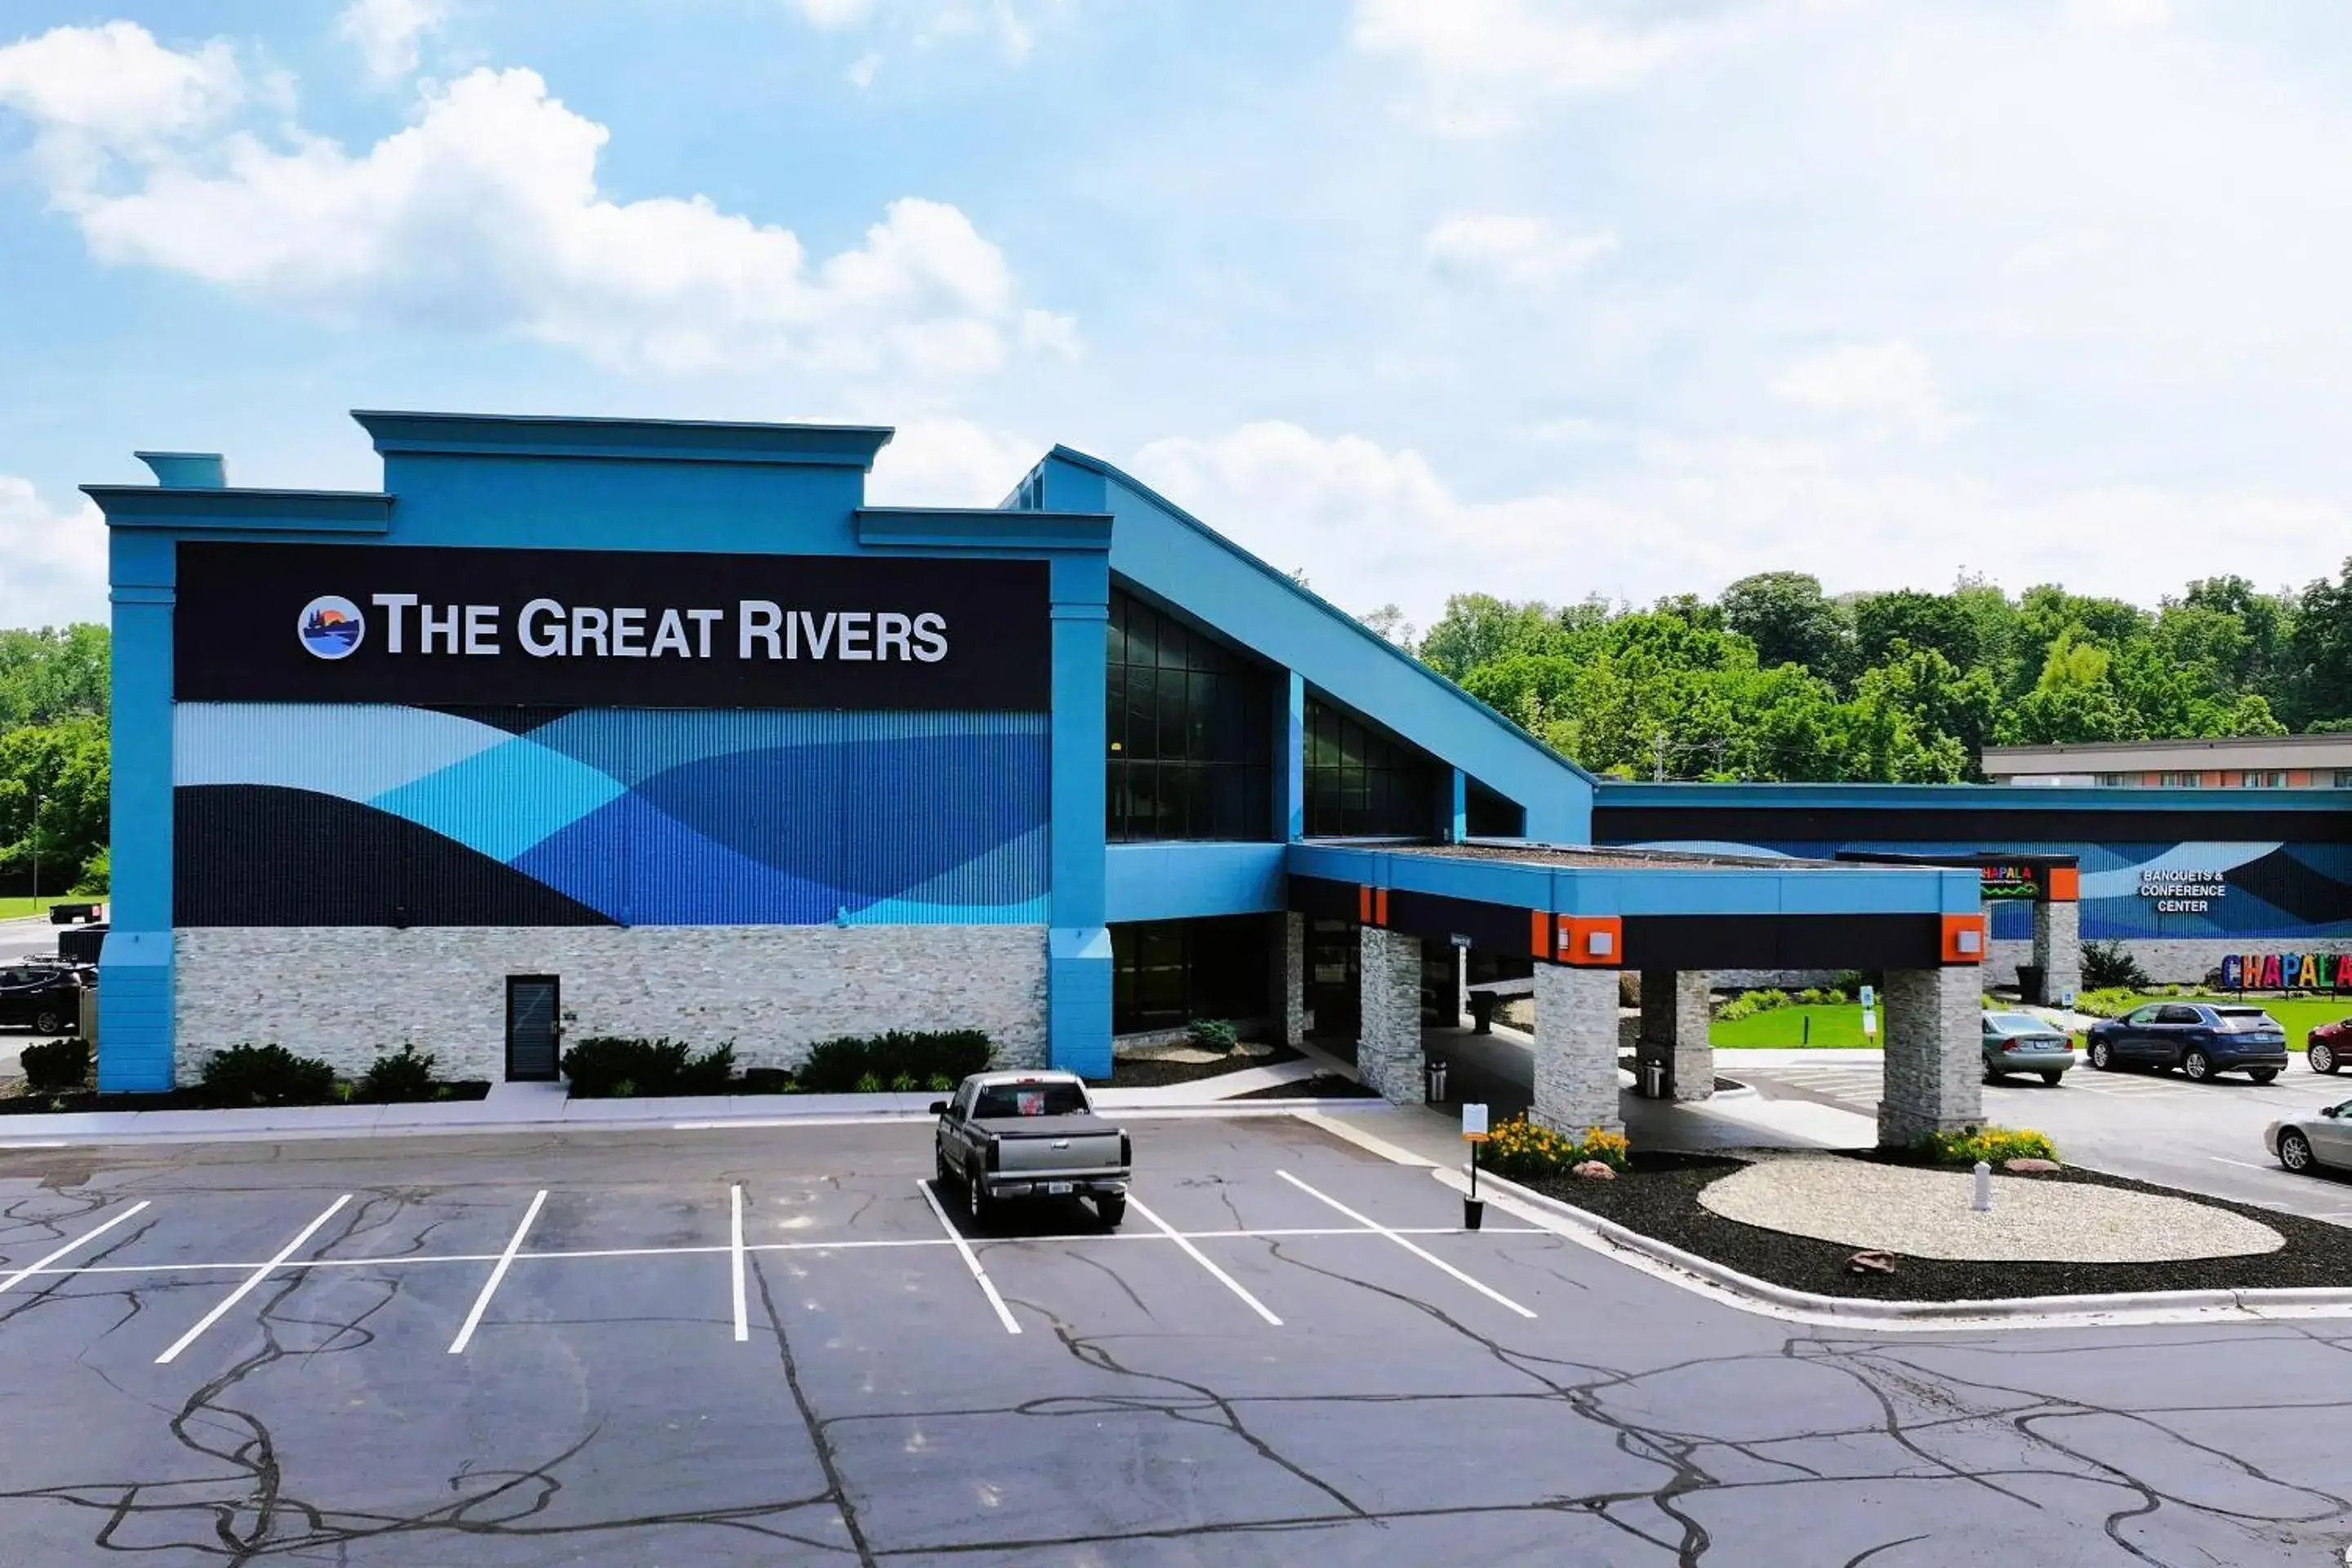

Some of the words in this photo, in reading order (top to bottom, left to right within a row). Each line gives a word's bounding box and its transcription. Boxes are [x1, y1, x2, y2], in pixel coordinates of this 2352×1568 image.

[372, 593, 500, 655] THE
[517, 598, 724, 659] GREAT
[739, 599, 948, 662] RIVERS
[1980, 866, 2032, 879] HAPALA
[2143, 870, 2212, 881] BANQUETS
[2215, 871, 2223, 881] &
[2140, 885, 2225, 897] CONFERENCE
[2157, 901, 2208, 912] CENTER
[2222, 954, 2352, 987] CHAPALA
